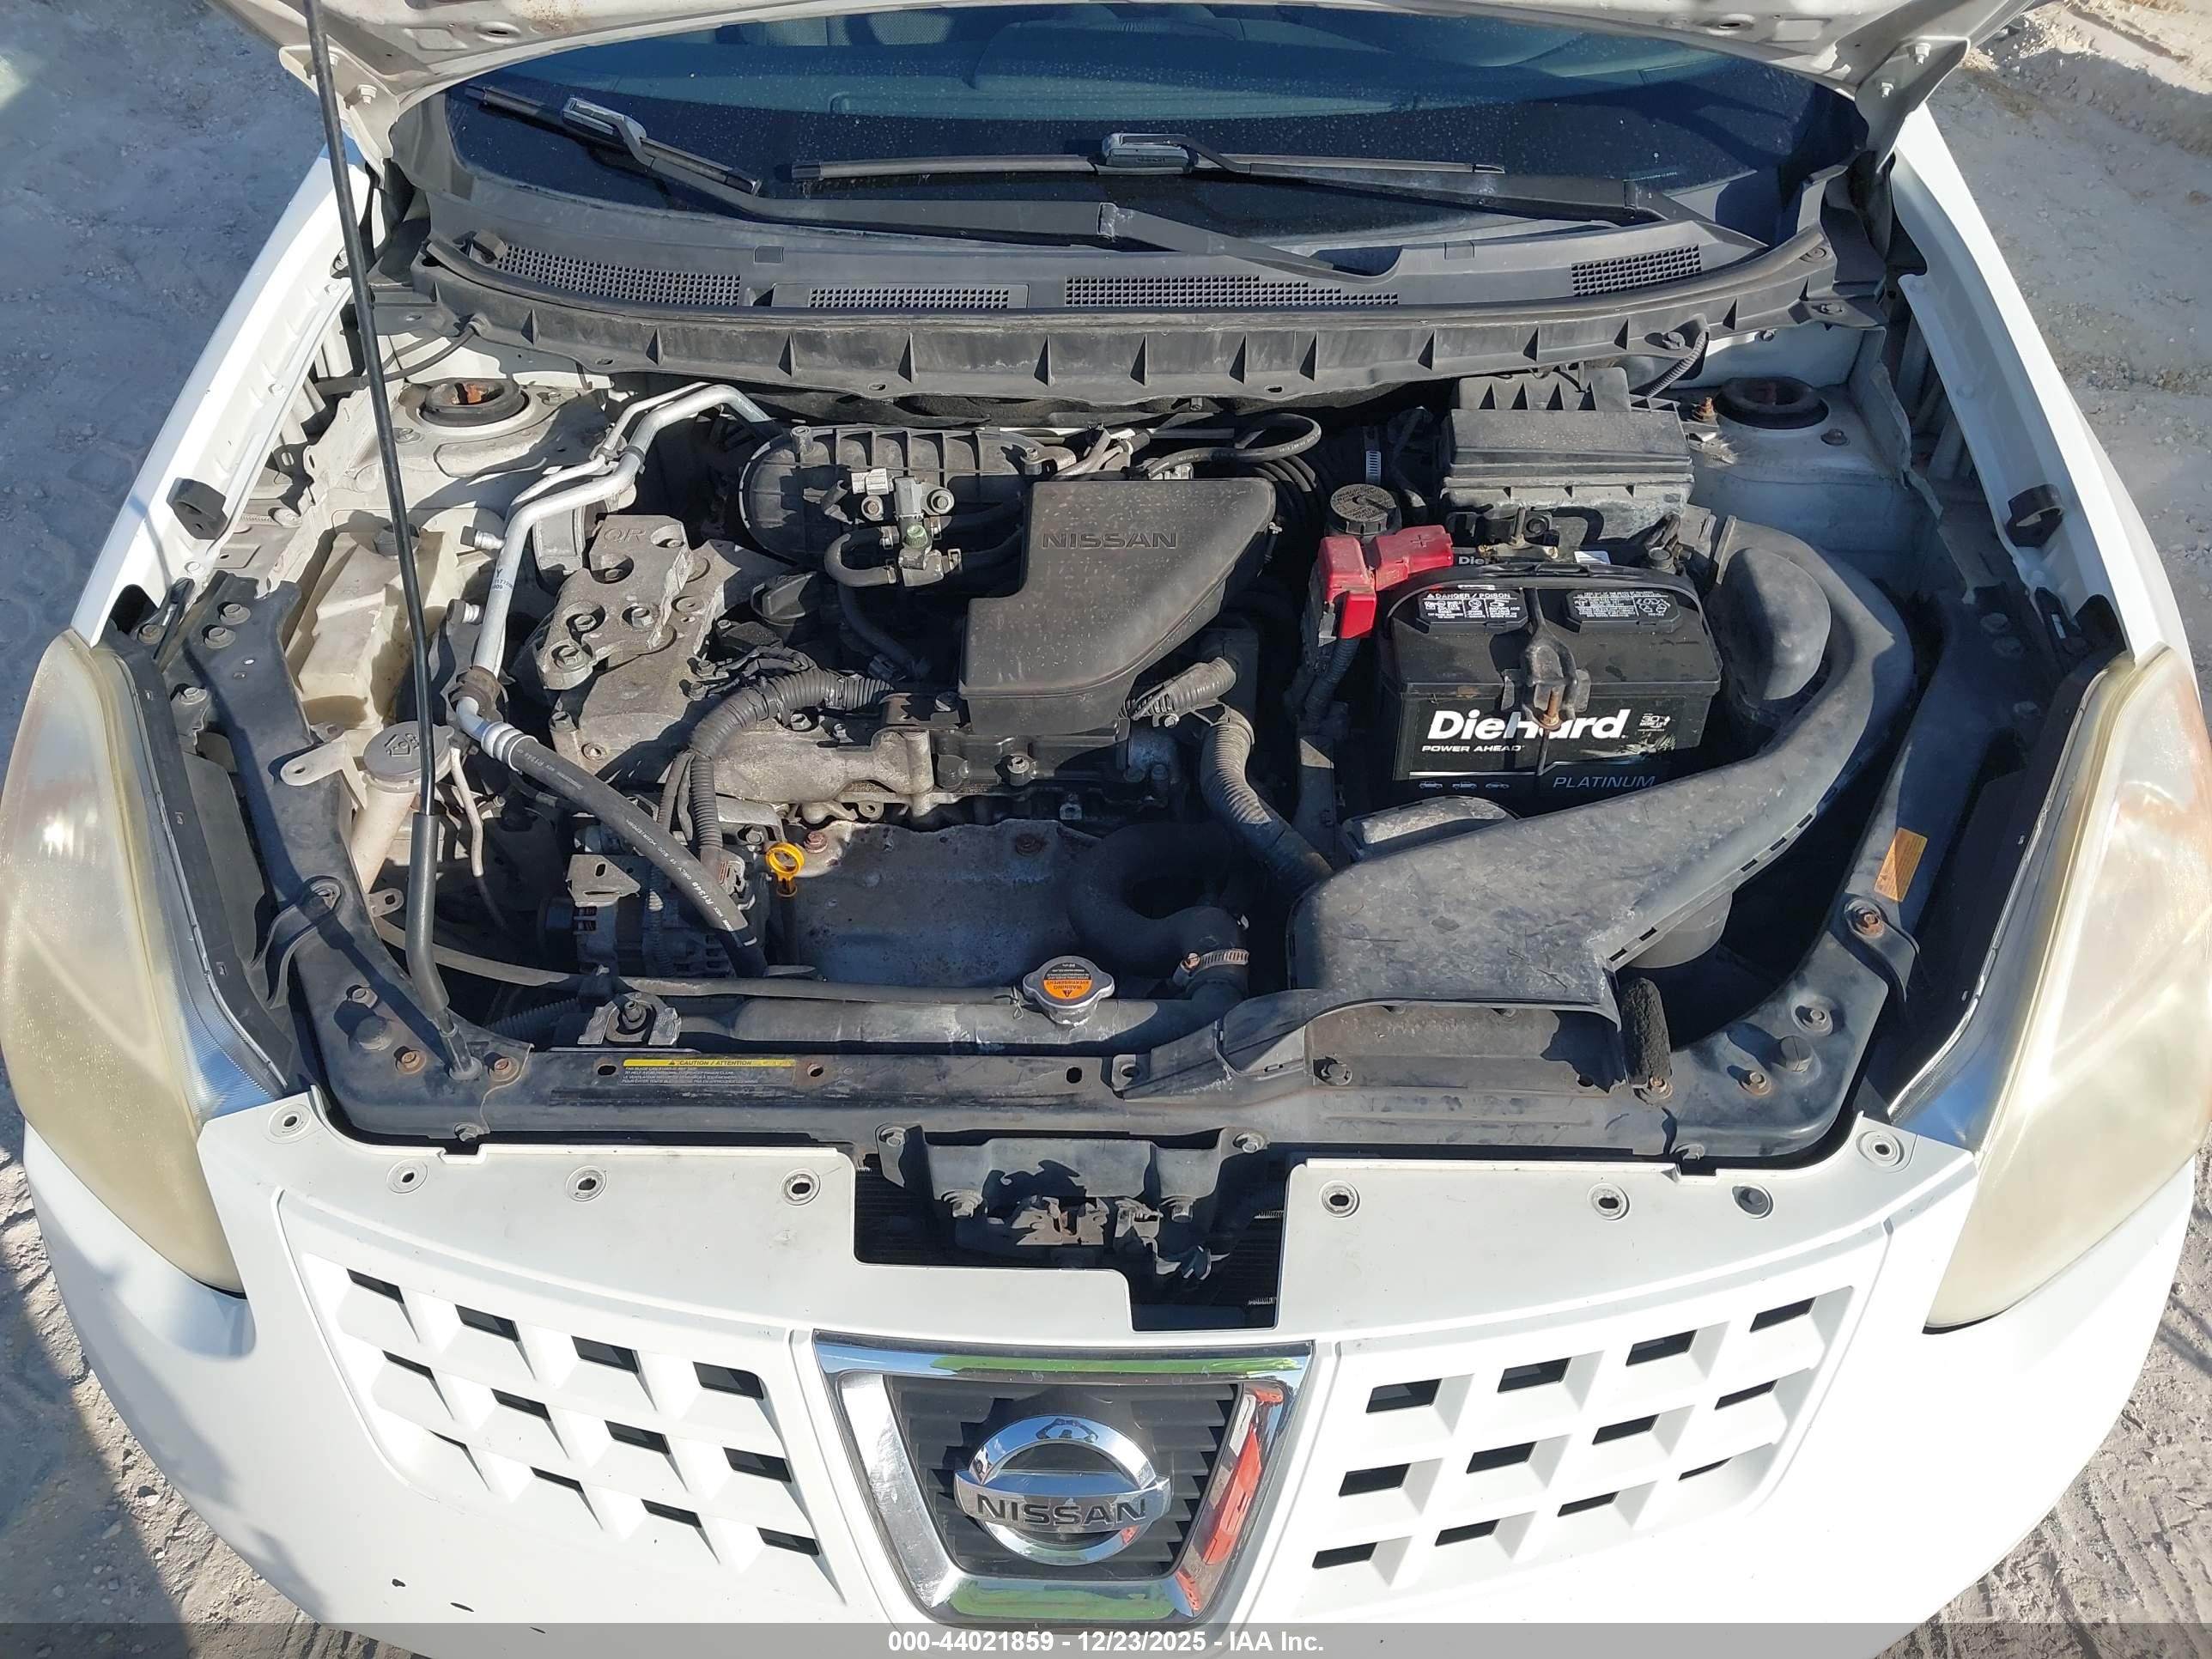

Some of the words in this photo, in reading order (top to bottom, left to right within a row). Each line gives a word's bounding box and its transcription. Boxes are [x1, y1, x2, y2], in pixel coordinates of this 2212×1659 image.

[604, 527, 646, 543] QR
[1042, 532, 1177, 550] NISSAN
[1458, 556, 1486, 565] Die
[1426, 708, 1631, 740] DieHard
[1553, 775, 1656, 788] PLATINUM
[976, 1493, 1146, 1526] NISSAN
